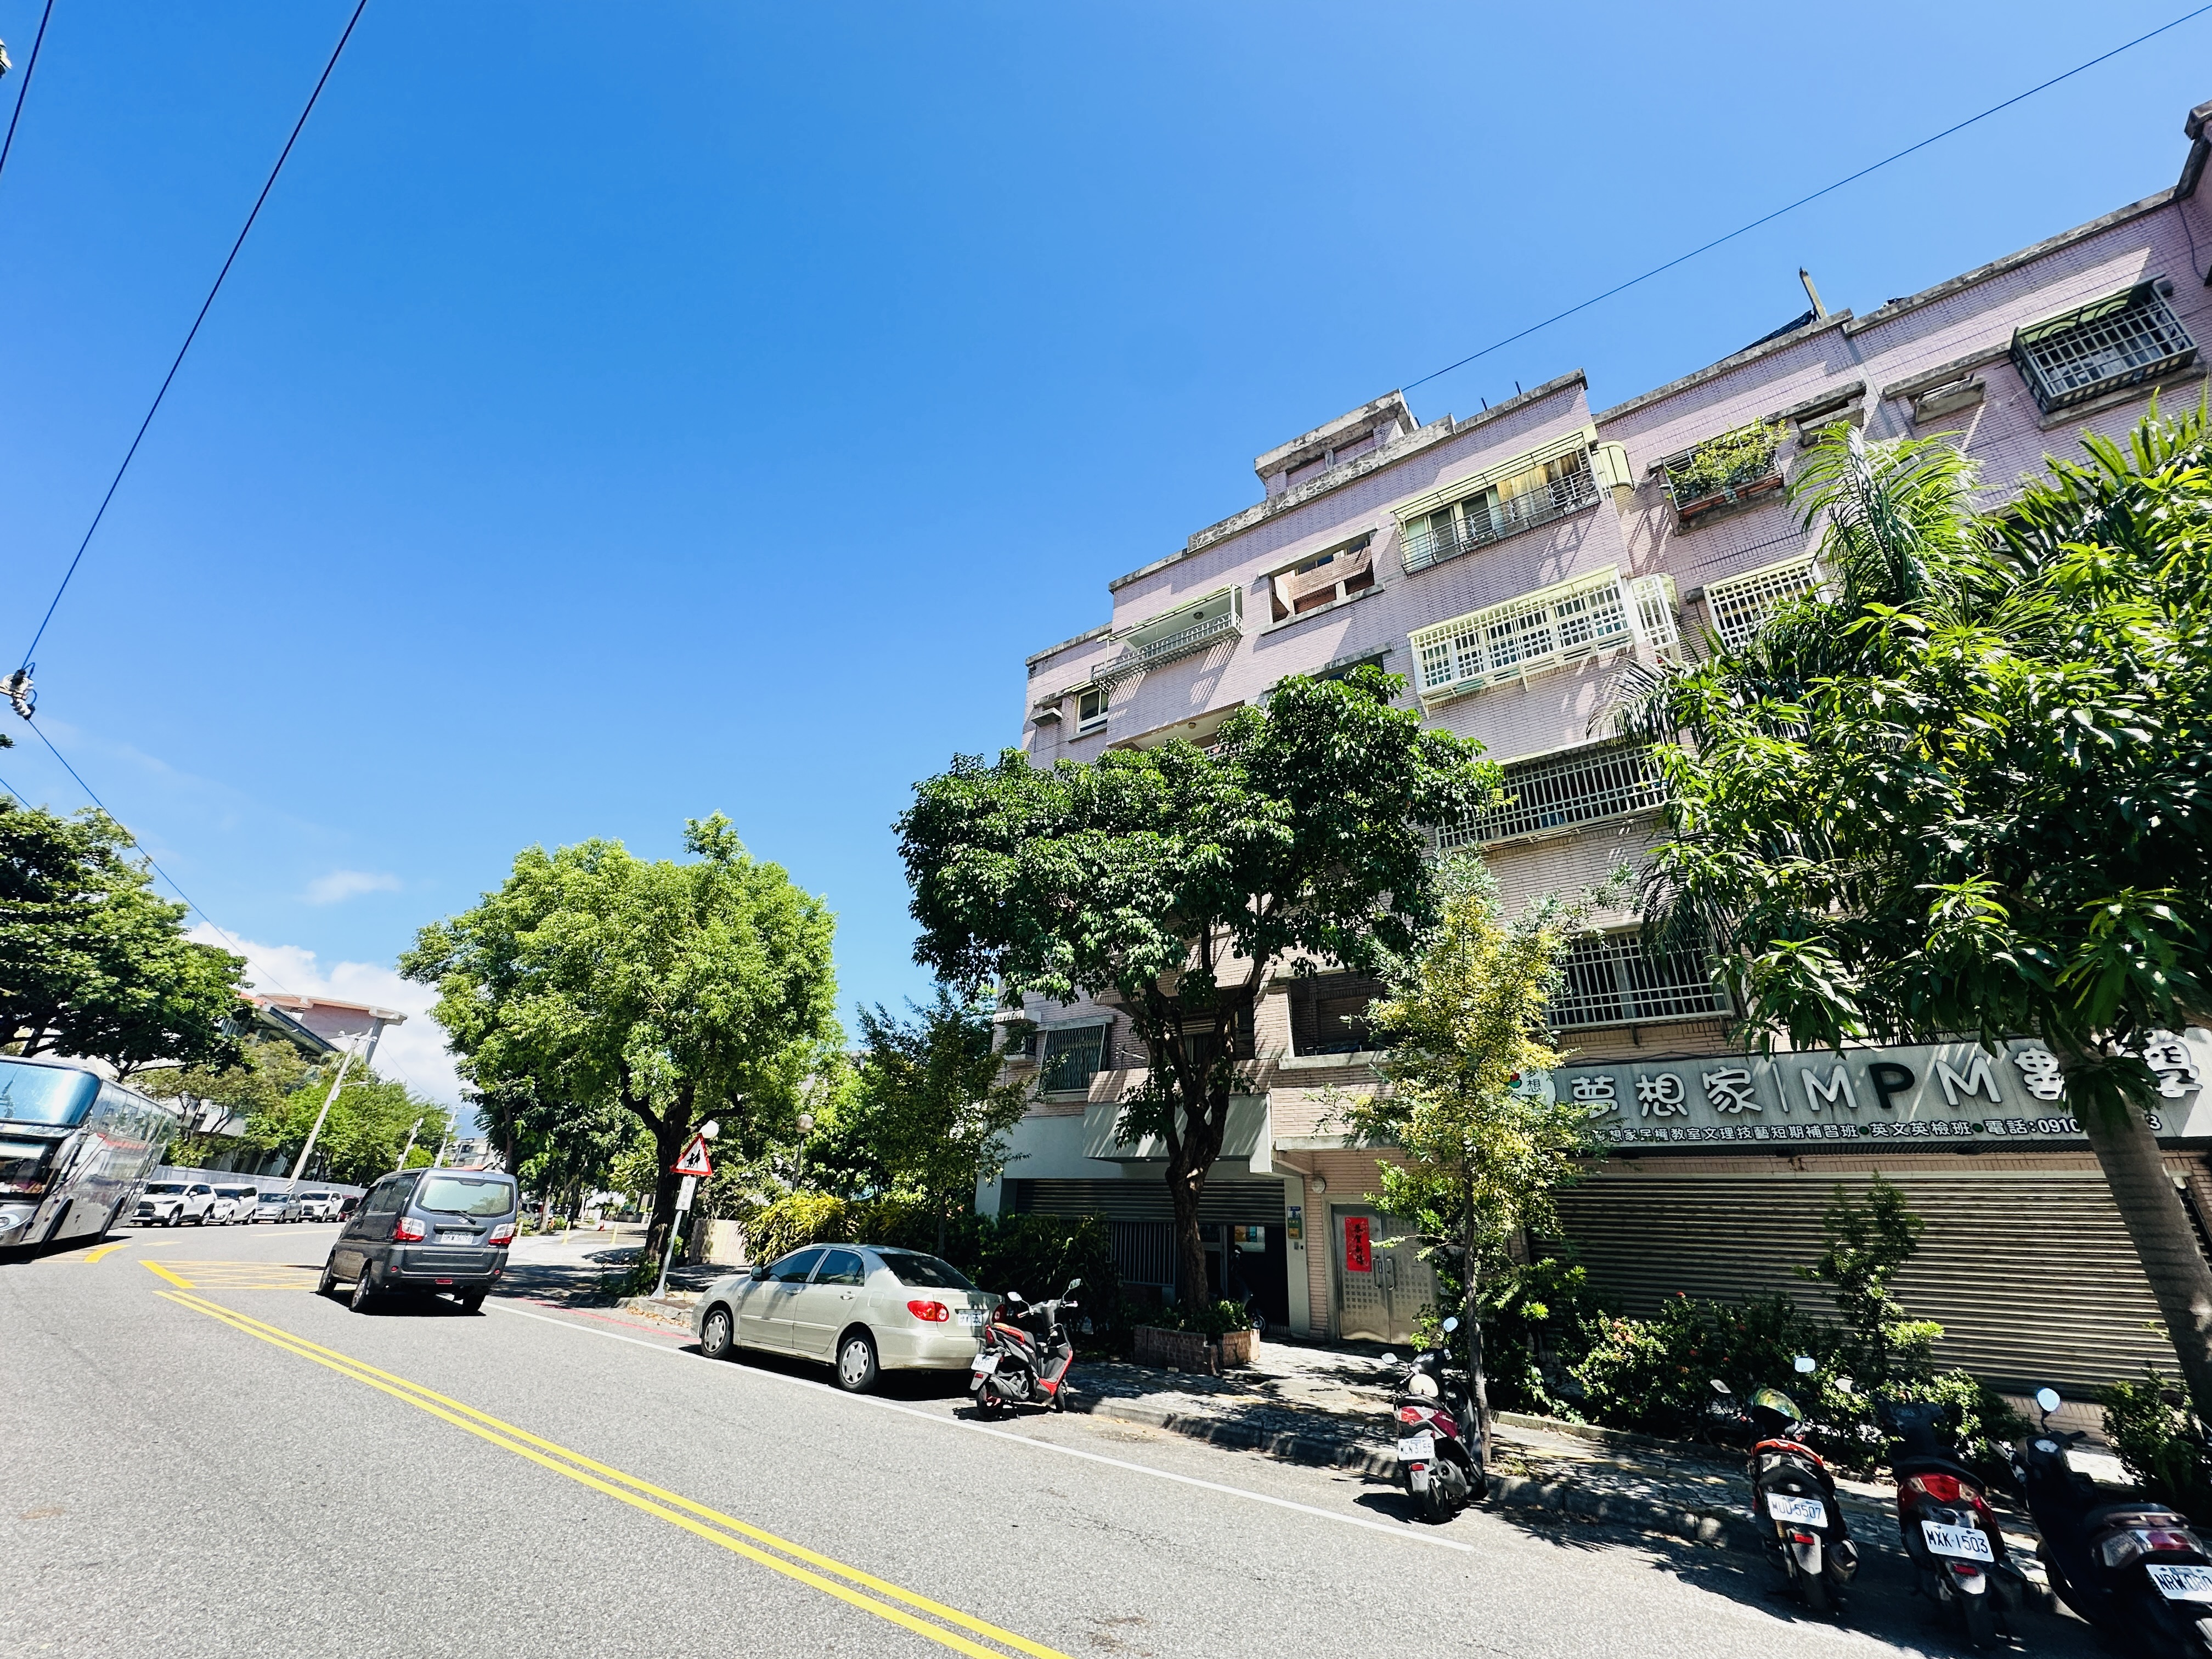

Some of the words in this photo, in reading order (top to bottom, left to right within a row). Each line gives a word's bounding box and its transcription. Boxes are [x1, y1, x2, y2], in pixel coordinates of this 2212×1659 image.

[1571, 1066, 1763, 1119] 夢想家
[1926, 1529, 1989, 1554] MXK-1503
